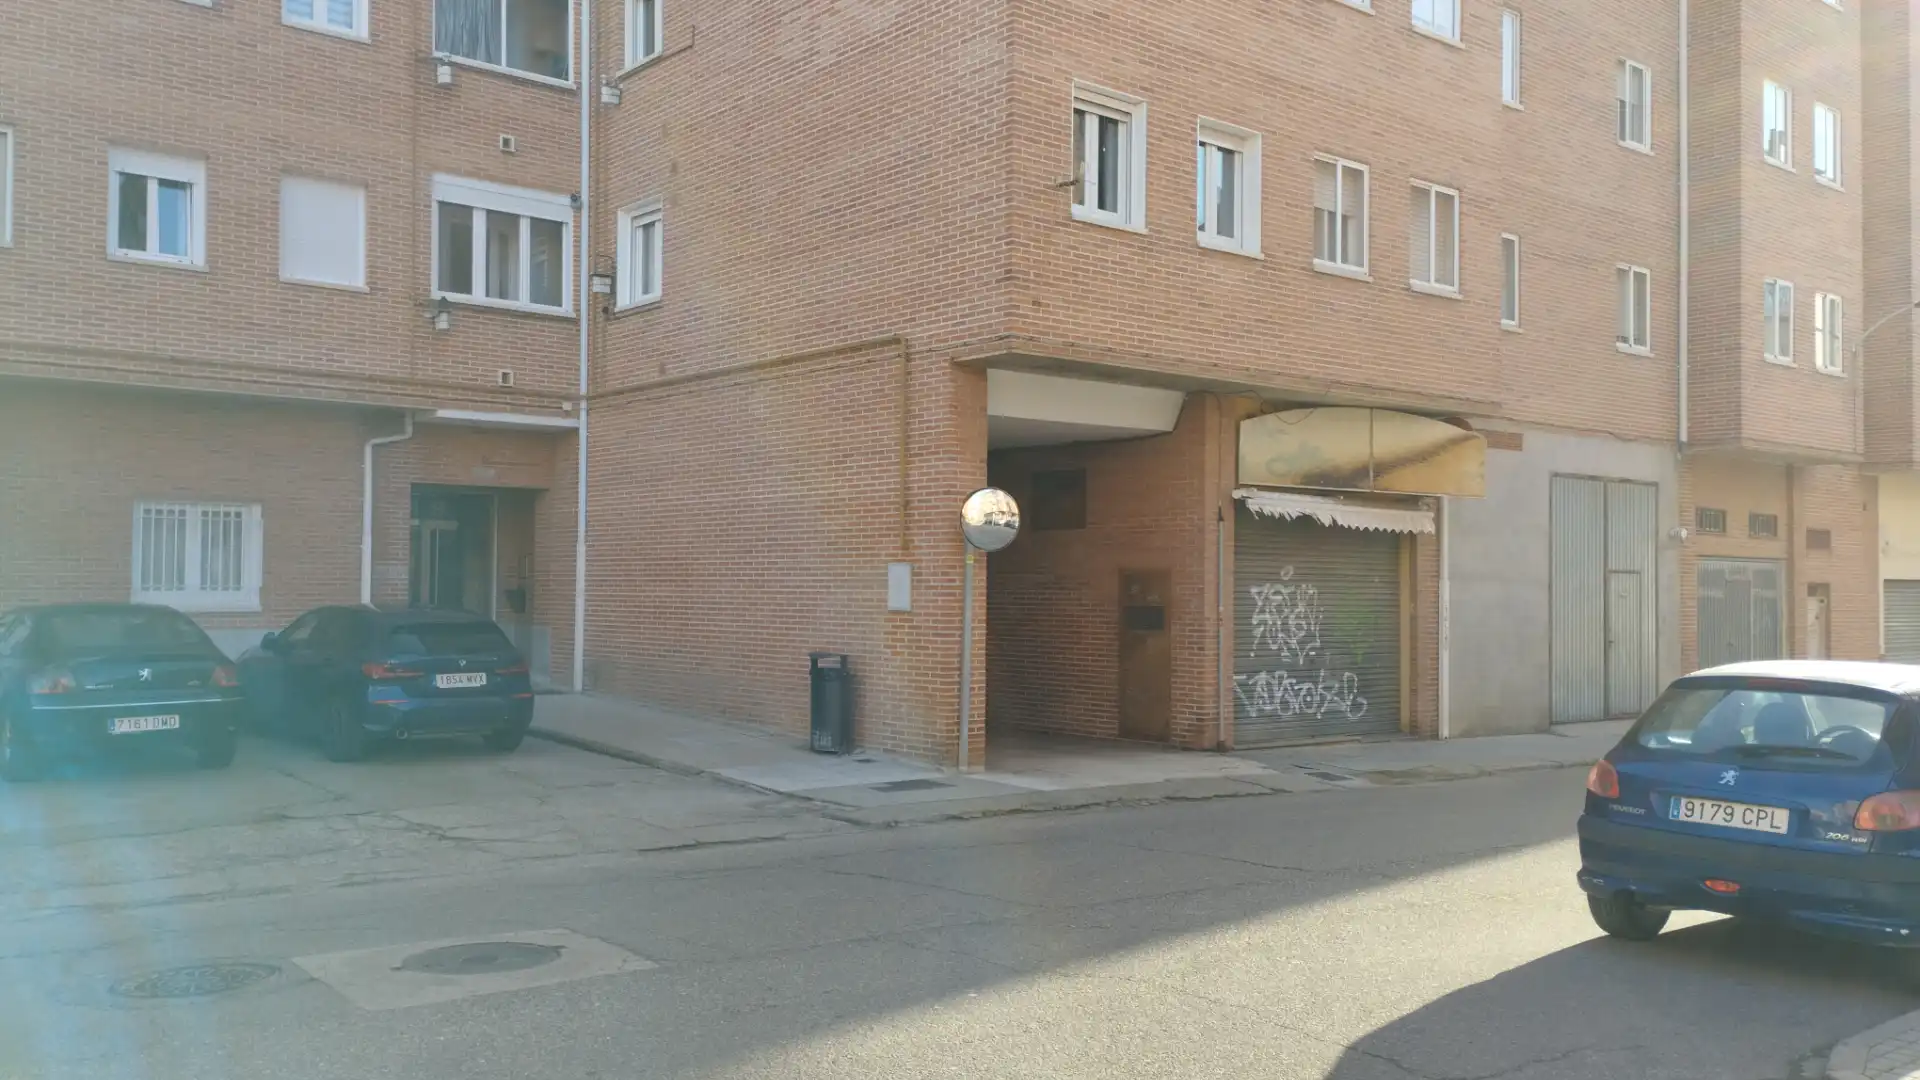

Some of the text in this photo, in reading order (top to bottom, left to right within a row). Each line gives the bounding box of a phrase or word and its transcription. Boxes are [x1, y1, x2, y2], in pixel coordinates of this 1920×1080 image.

[117, 718, 148, 730] 7161
[1684, 801, 1782, 830] 9179 CPL
[1824, 832, 1850, 841] 206
